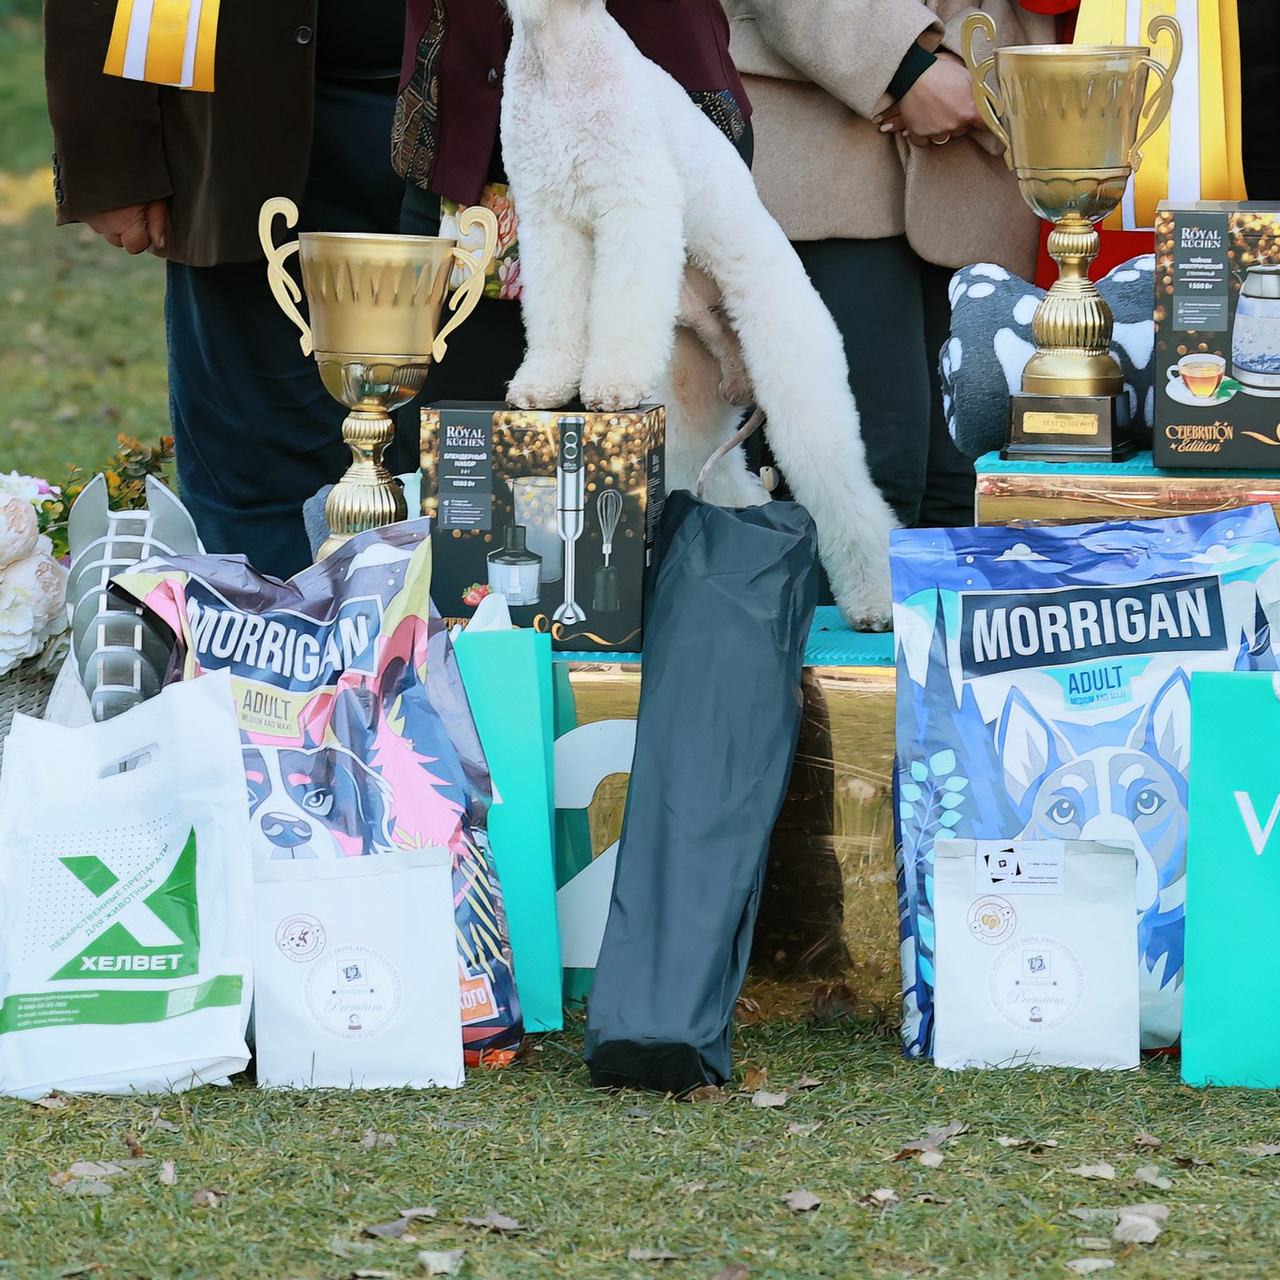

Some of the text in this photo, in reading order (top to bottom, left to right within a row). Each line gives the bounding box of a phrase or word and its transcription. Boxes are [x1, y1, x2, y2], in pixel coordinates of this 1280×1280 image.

[1181, 227, 1222, 240] ROYAL
[446, 425, 485, 438] ROYAL
[1165, 423, 1234, 441] CELEBRATION
[1178, 439, 1221, 452] Edition
[972, 587, 1212, 663] MORRIGAN
[186, 596, 371, 682] MORRIGAN
[1069, 666, 1122, 694] ADULT
[243, 689, 291, 721] ADULT
[50, 842, 169, 952] ЛЕКАРСТВЕННЫЕ ПРЕПАРАТЫ
[85, 878, 155, 937] ДЛЯ ЖИВОТНЫХ
[80, 953, 184, 972] ХЕЛВЕТ
[324, 999, 382, 1013] Premium
[1006, 990, 1064, 1004] Premium
